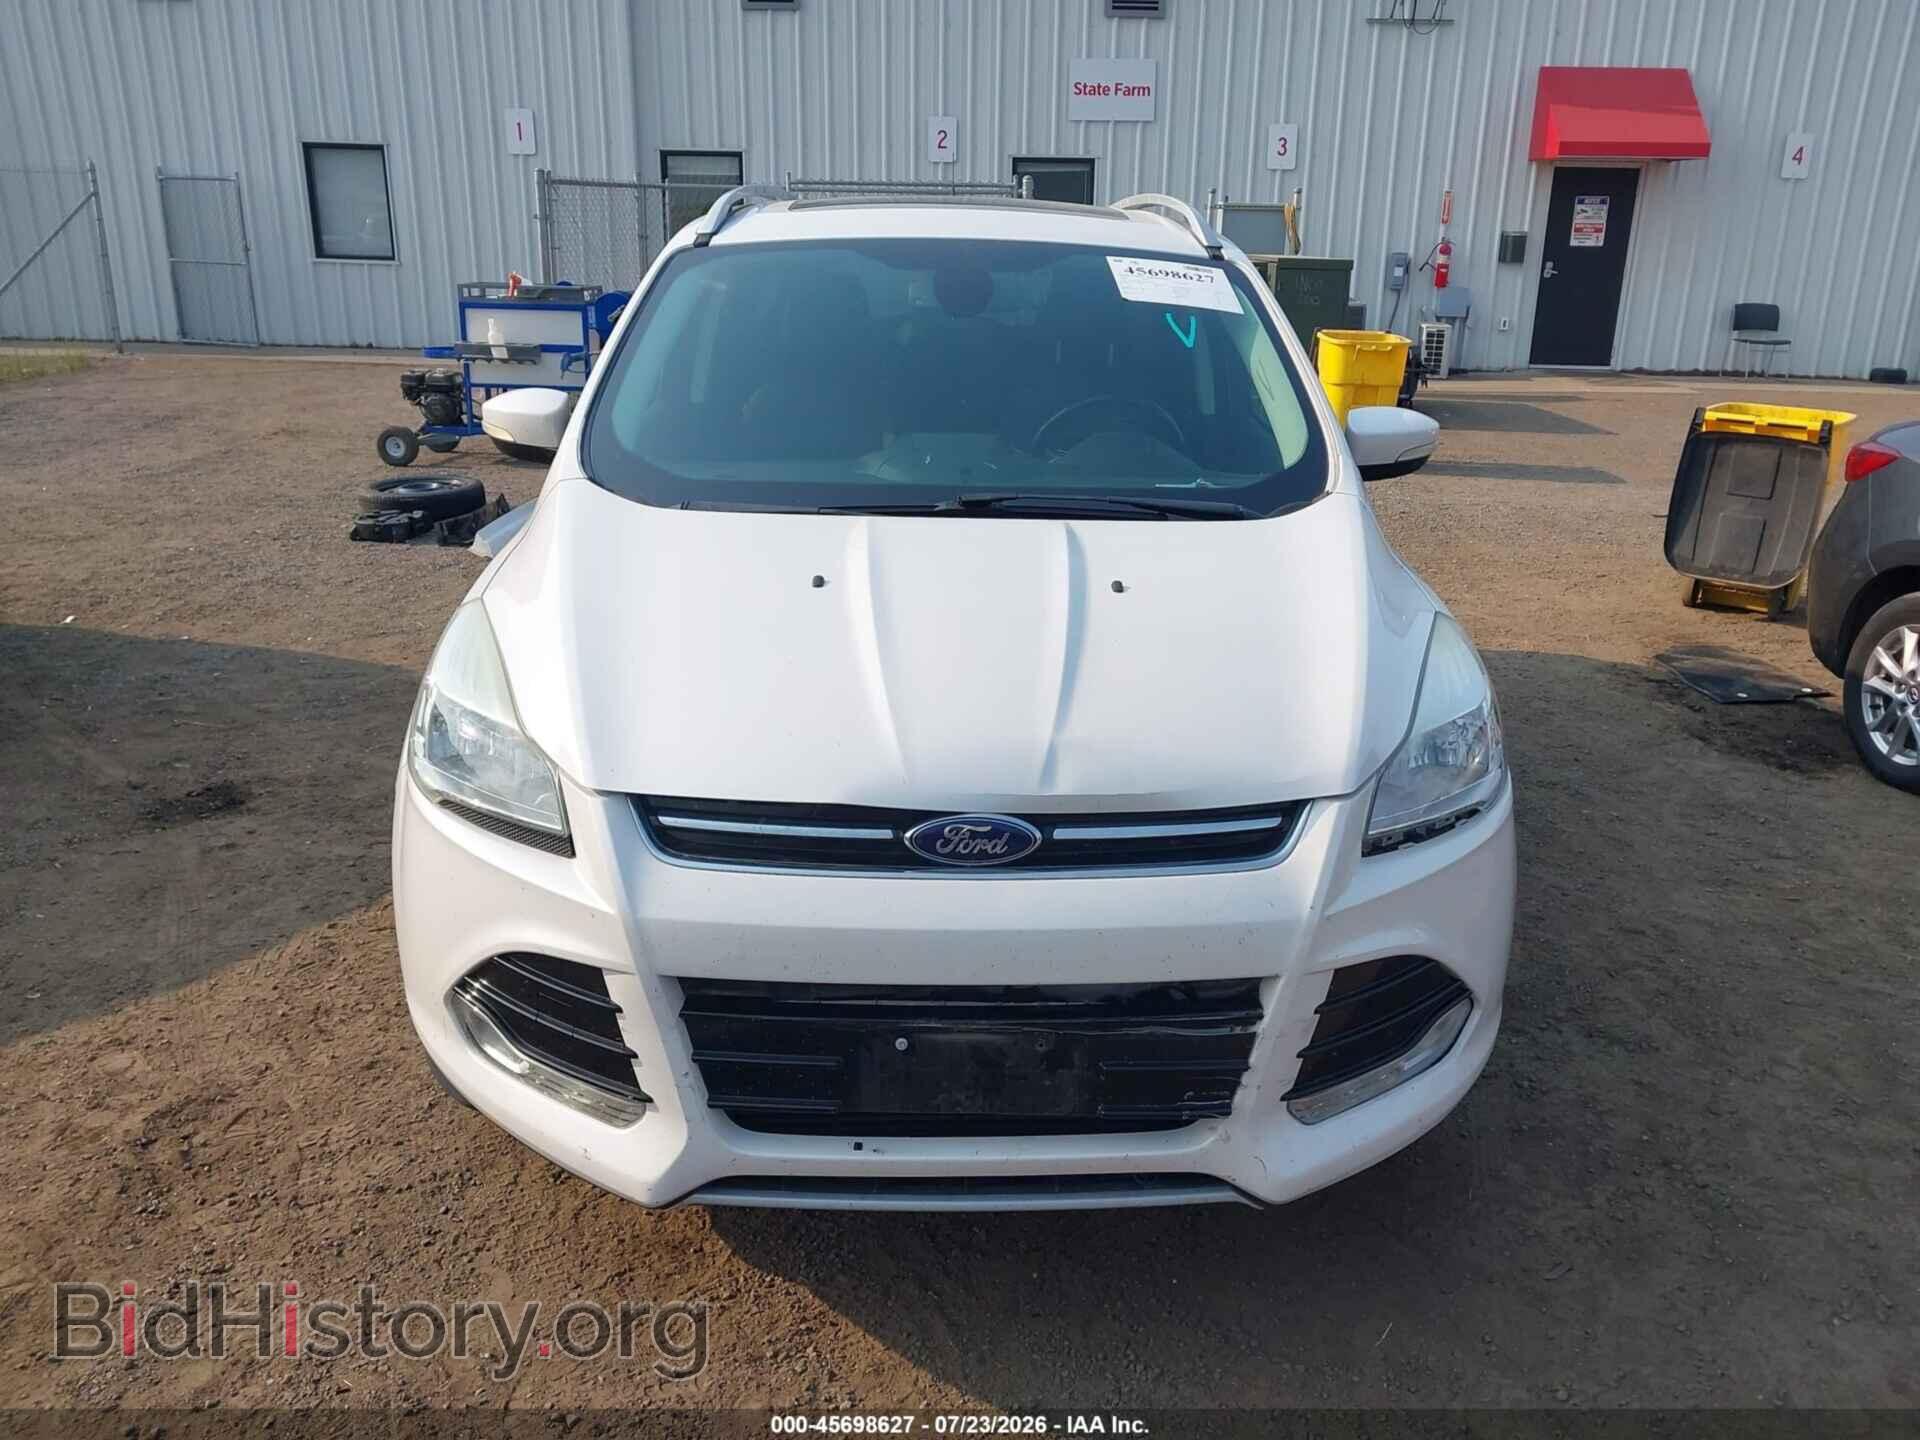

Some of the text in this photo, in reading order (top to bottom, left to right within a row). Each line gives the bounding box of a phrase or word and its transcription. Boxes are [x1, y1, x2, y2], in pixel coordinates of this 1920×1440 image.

[1073, 82, 1151, 97] State Farm
[516, 122, 523, 141] 1
[937, 130, 948, 149] 2
[1277, 137, 1289, 156] 3
[1791, 146, 1804, 165] 4
[1124, 266, 1215, 284] 45698627
[935, 824, 1010, 855] Ford
